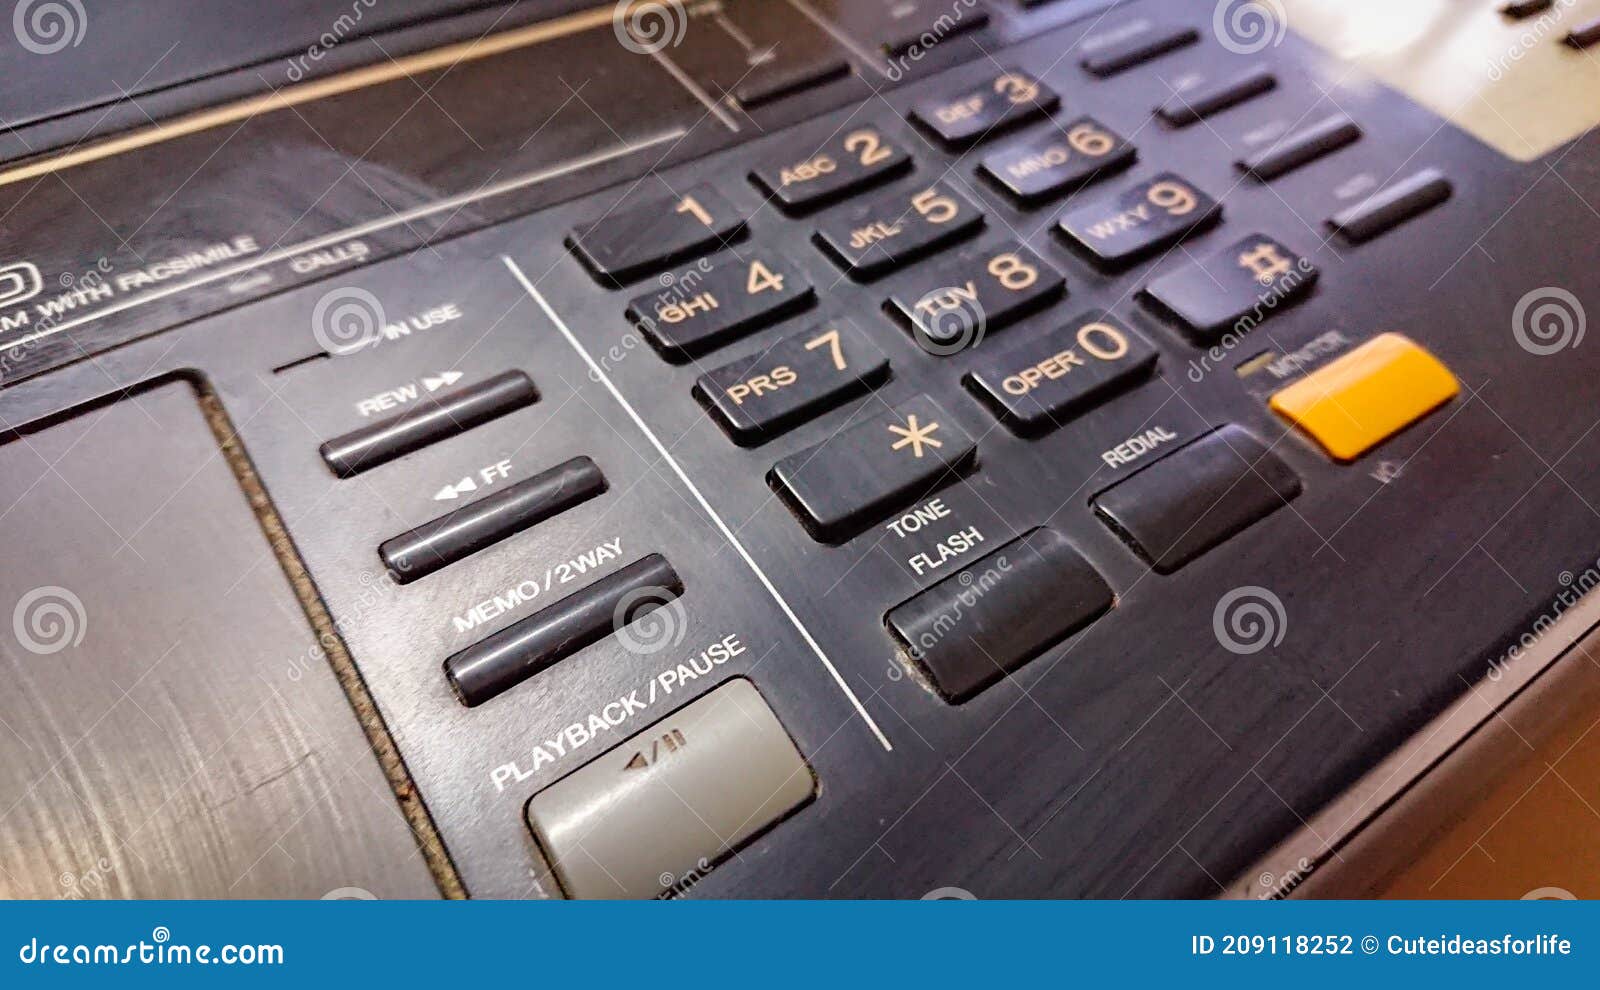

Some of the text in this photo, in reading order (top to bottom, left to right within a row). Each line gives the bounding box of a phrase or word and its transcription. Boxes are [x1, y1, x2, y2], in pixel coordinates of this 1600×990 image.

[935, 73, 1039, 125] DEF 3
[779, 129, 893, 187] ABC 2
[1007, 122, 1113, 179] MNO 6
[676, 195, 714, 226] 1
[849, 188, 959, 249] JKL 5
[1086, 181, 1199, 239] WXY 9
[115, 235, 261, 293] FACSIMILE
[746, 259, 785, 295] 4
[914, 252, 1040, 318] TUV 8
[410, 303, 464, 331] USE
[659, 291, 720, 325] GHI
[726, 329, 847, 405] PRS 7
[1001, 322, 1130, 396] OPER 0
[356, 382, 419, 417] REW
[480, 459, 513, 485] FF
[1101, 426, 1178, 469] REDIAL
[886, 498, 951, 538] TONE
[907, 525, 985, 576] FLASH
[489, 633, 747, 793] PLAYBACK/PAUSE
